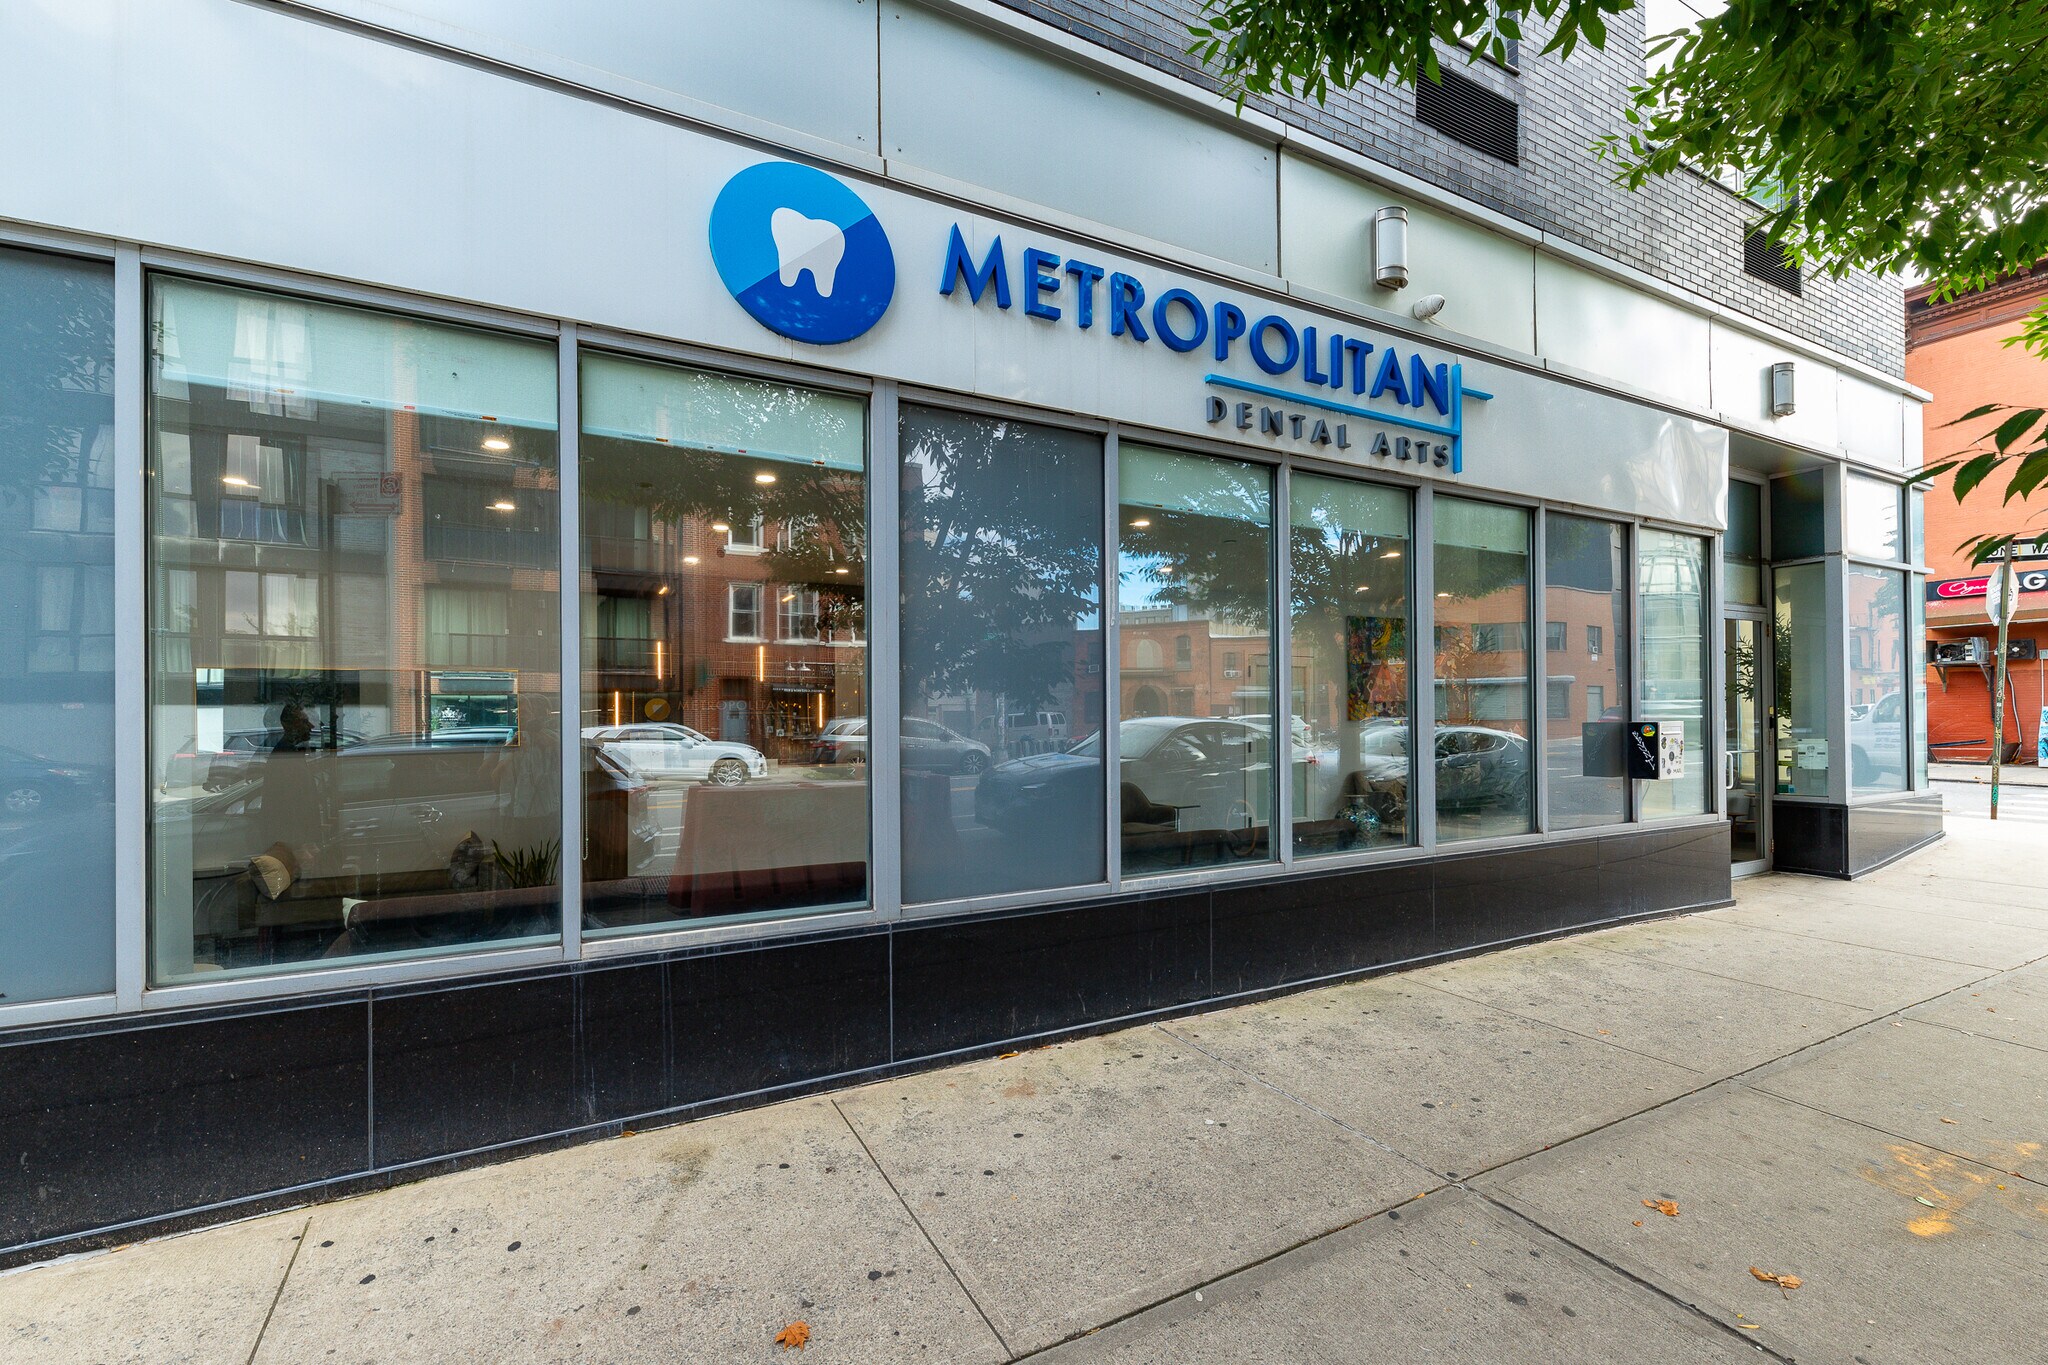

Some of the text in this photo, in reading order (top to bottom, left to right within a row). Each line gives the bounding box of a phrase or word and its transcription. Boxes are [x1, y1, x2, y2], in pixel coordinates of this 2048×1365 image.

[939, 222, 1449, 416] METROPOLITAN
[1206, 395, 1449, 468] DENTAL ARTS
